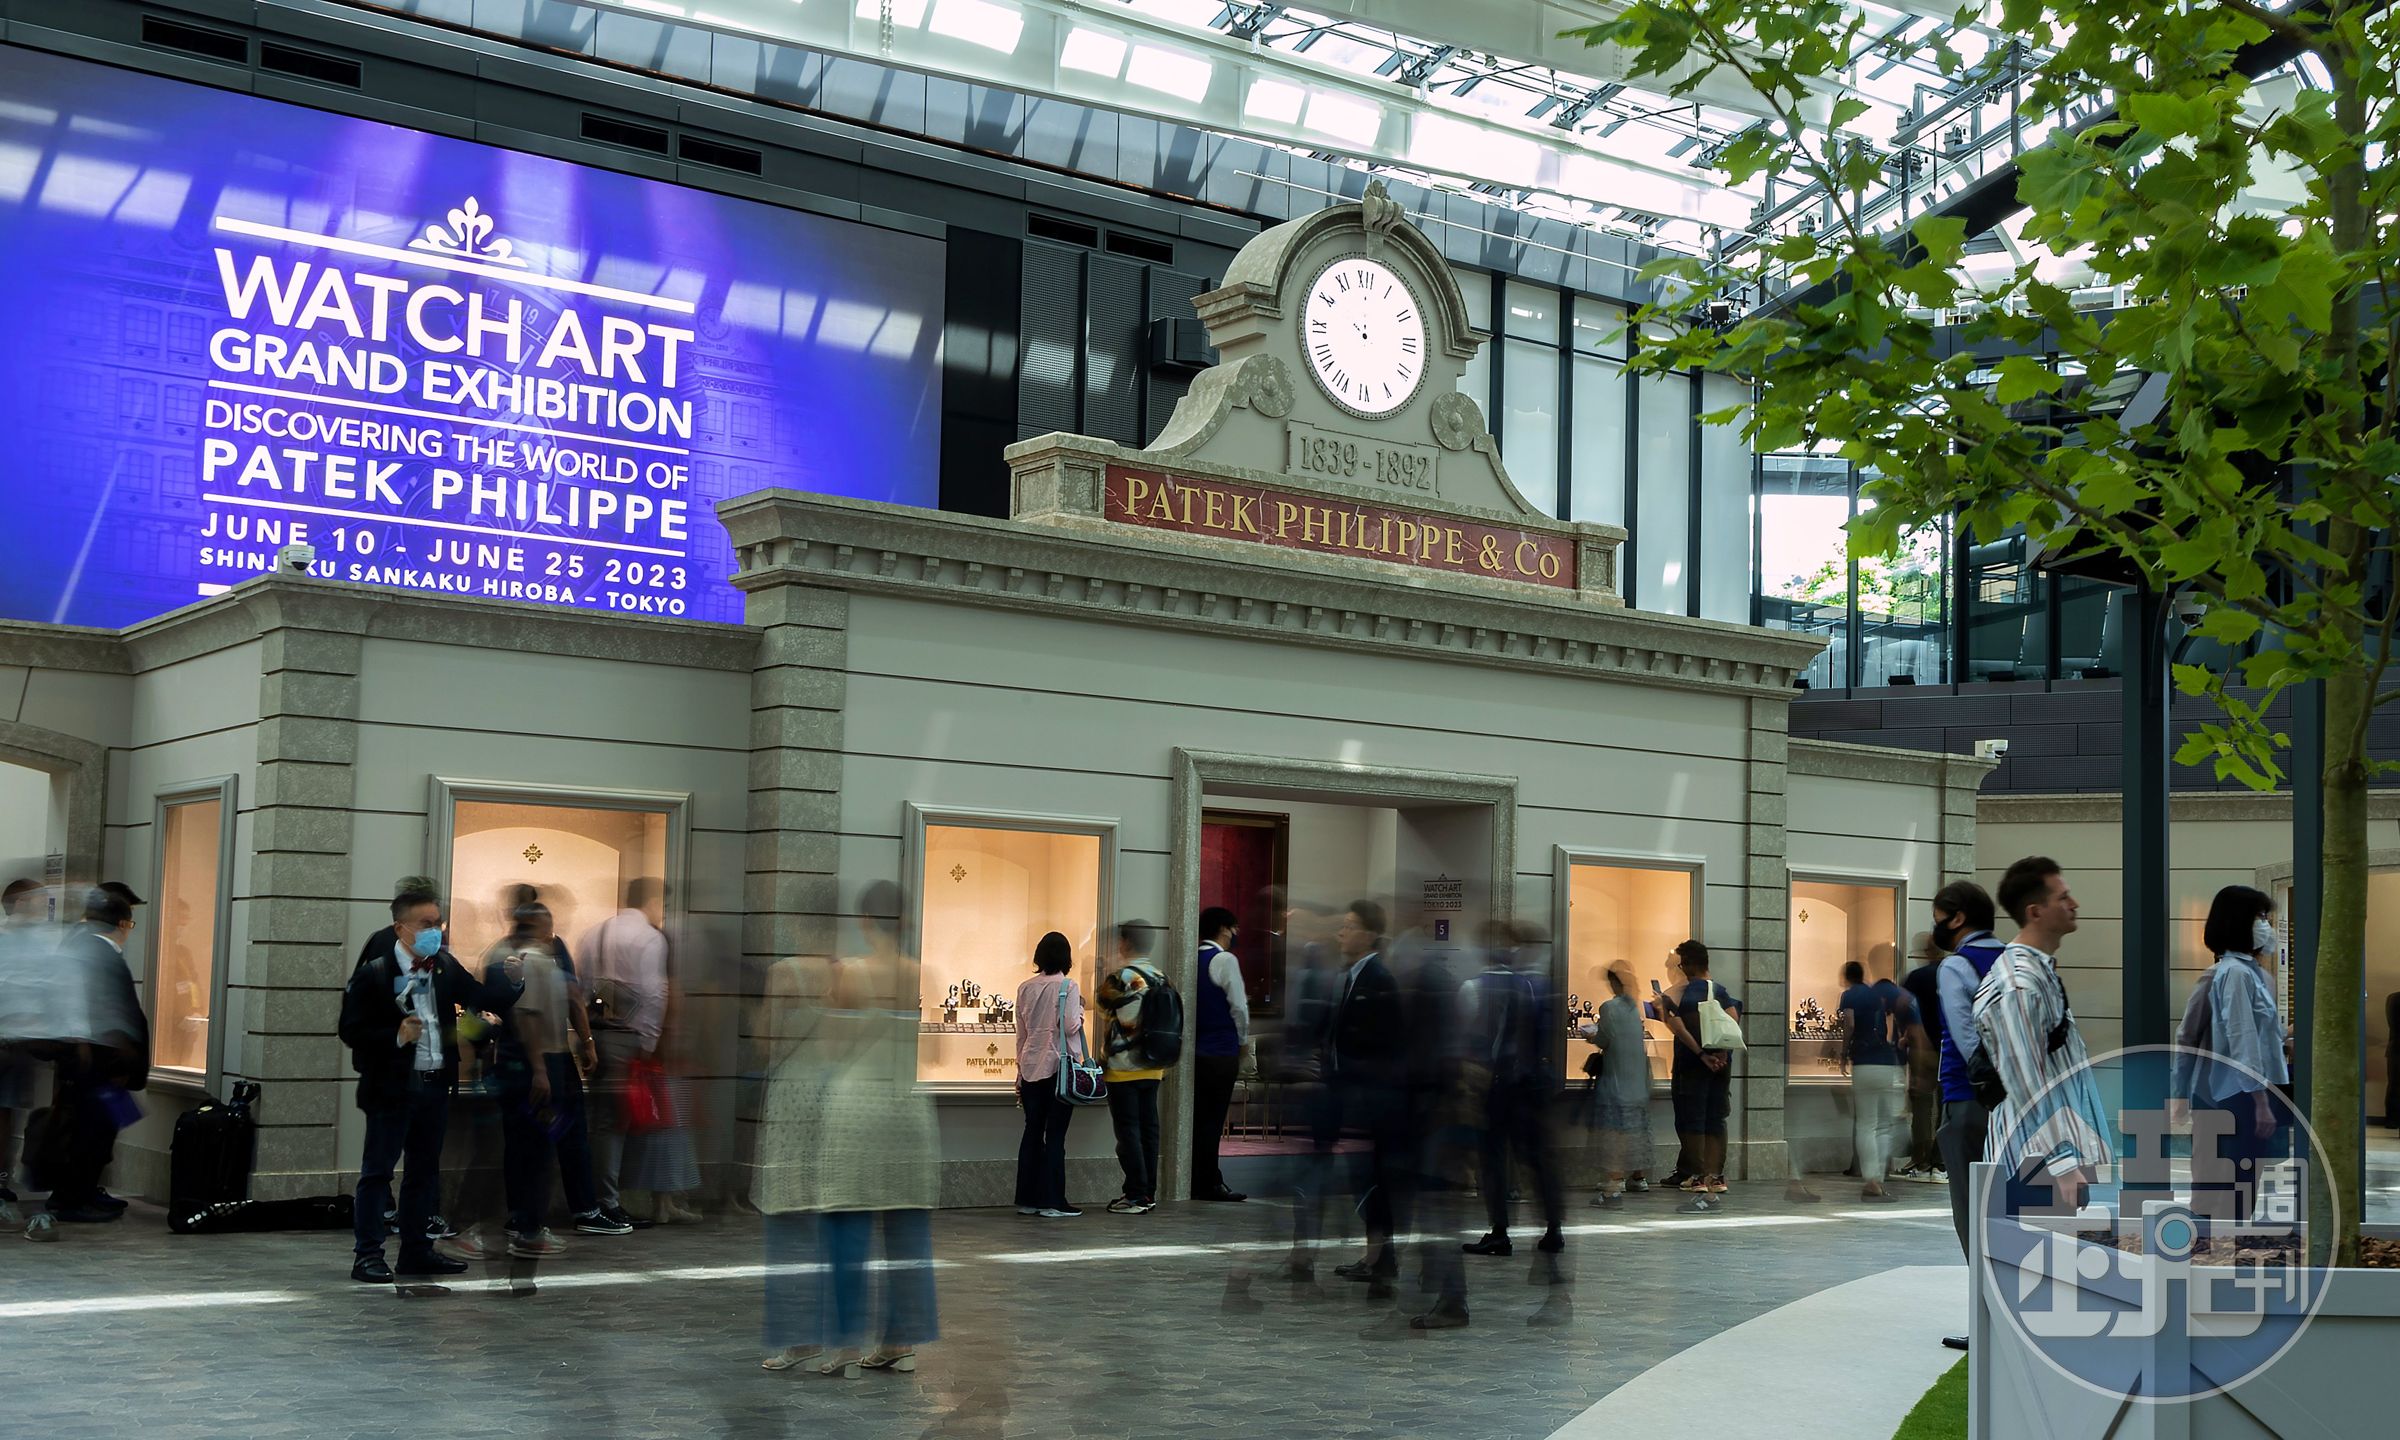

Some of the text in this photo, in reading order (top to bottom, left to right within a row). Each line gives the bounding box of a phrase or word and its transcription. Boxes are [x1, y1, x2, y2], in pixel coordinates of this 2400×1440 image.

[214, 247, 695, 389] WATCH ART
[209, 328, 692, 439] GRAND EXHIBITION
[205, 399, 689, 490] DISCOVERING THE WORLD OF
[202, 438, 688, 540] PATEK PHILIPPE
[1124, 477, 1260, 534] PATEK
[1275, 500, 1464, 565] PHILIPPE
[1478, 534, 1504, 571] &
[200, 513, 308, 546] JUNE
[332, 527, 376, 555] 10
[427, 539, 525, 572] JUNE
[545, 552, 584, 578] 25
[604, 559, 687, 590] 2023
[200, 547, 336, 577] SHINJKU
[349, 563, 471, 592] SANKAKU
[483, 577, 575, 603] HIROBA
[606, 591, 686, 615] TOKYO
[1424, 883, 1462, 892] WATCH ART
[1439, 924, 1445, 935] 5
[966, 1058, 988, 1066] PATEK
